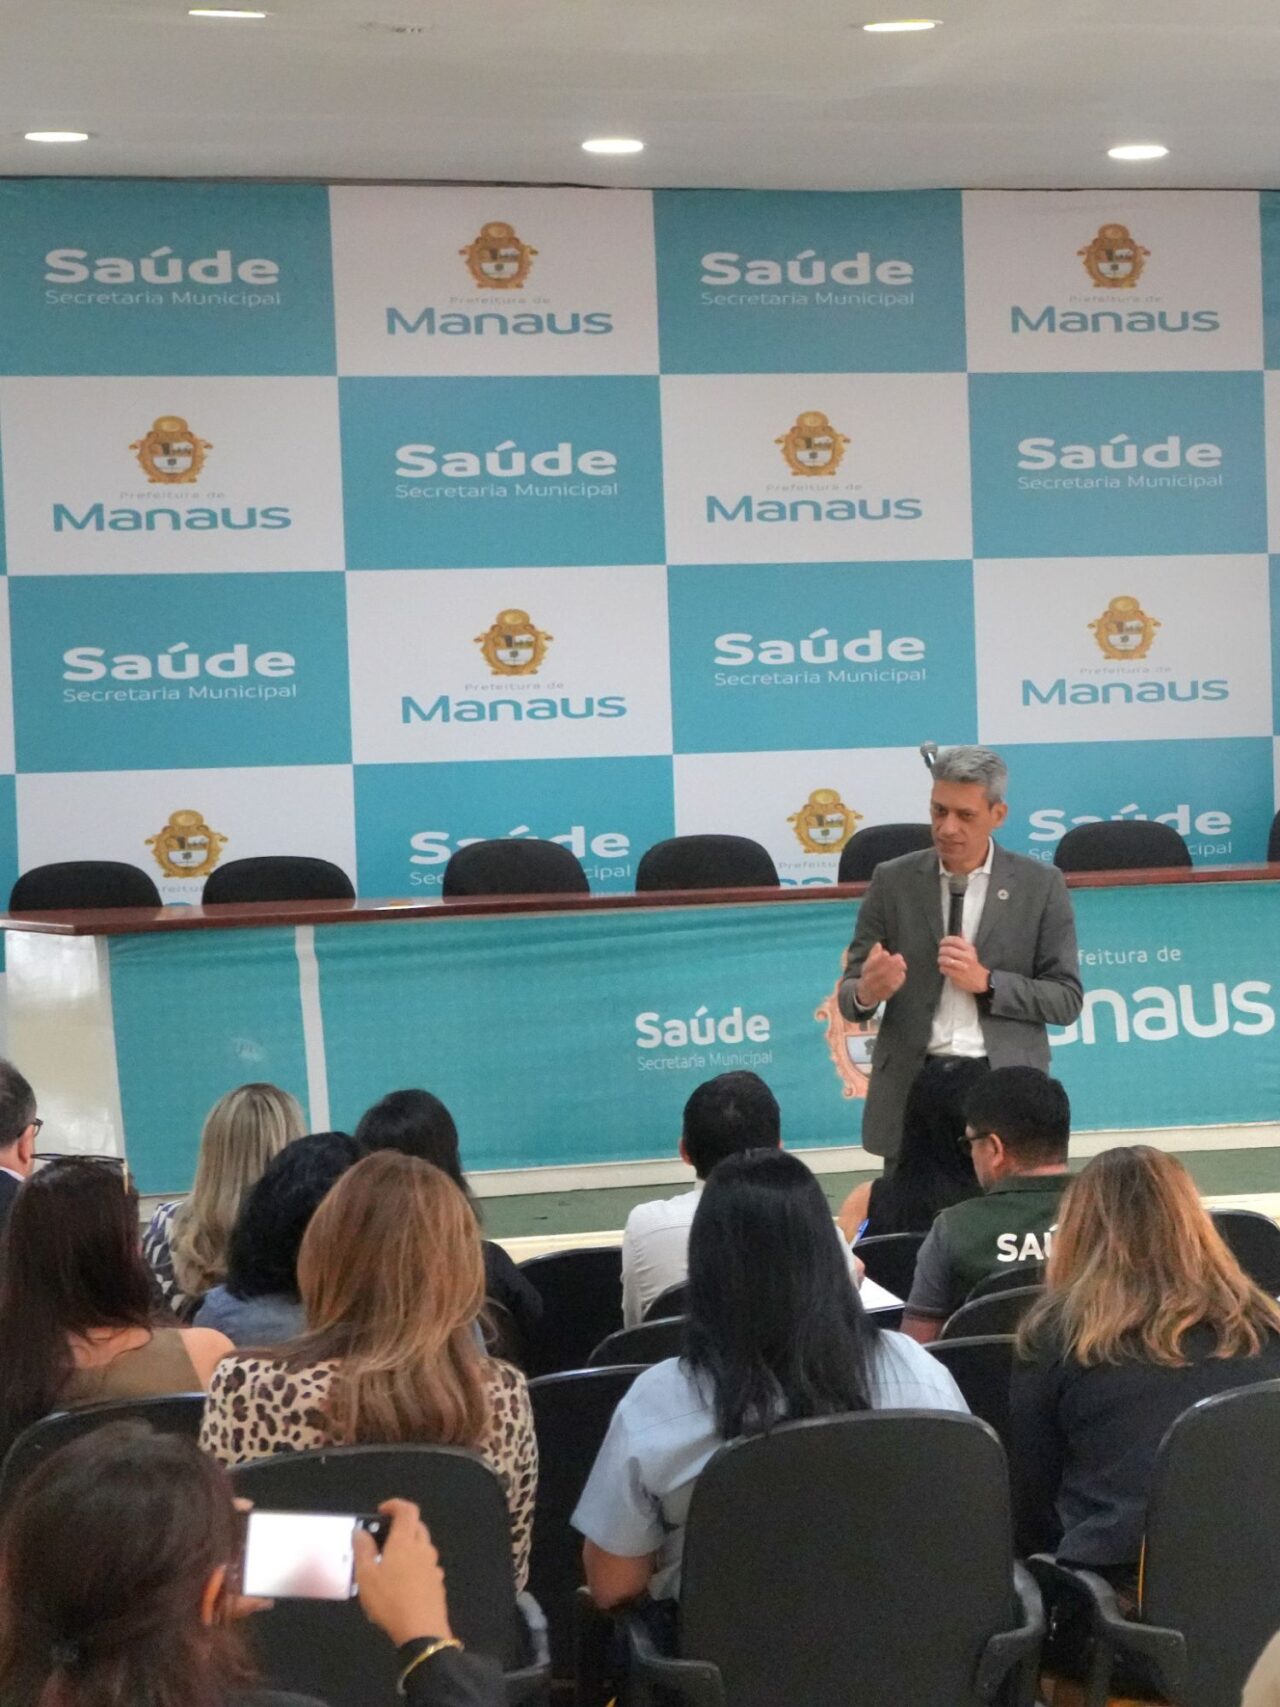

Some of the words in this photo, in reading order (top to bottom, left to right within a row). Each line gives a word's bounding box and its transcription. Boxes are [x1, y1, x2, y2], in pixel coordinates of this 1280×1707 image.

[44, 246, 280, 284] Saúde
[700, 249, 914, 286] Saúde
[45, 289, 164, 305] Secretaria
[171, 290, 281, 307] Municipal
[700, 290, 808, 306] Secretaria
[814, 290, 915, 307] Municipal
[385, 306, 614, 336] Manaus
[1010, 305, 1220, 334] Manaus
[394, 440, 618, 478] Saúde
[1017, 434, 1223, 470] Saúde
[394, 484, 508, 499] Secretaria
[515, 482, 619, 499] Municipal
[1017, 475, 1121, 490] Secretaria
[1127, 473, 1224, 490] Municipal
[53, 502, 292, 532] Manaus
[705, 495, 923, 523] Manaus
[62, 641, 296, 681] Saúde
[713, 628, 927, 666] Saúde
[713, 669, 822, 686] Secretaria
[828, 668, 927, 685] Municipal
[62, 686, 182, 703] Secretaria
[188, 684, 297, 702] Municipal
[1021, 678, 1230, 707] Manaus
[401, 694, 628, 724] Manaus
[1189, 841, 1232, 858] cipal
[1077, 948, 1148, 966] feitura
[1156, 946, 1182, 962] de
[635, 1005, 771, 1049] Saúde
[1049, 980, 1276, 1046] naus
[636, 1054, 706, 1072] Secretaria
[709, 1049, 773, 1068] Municipal
